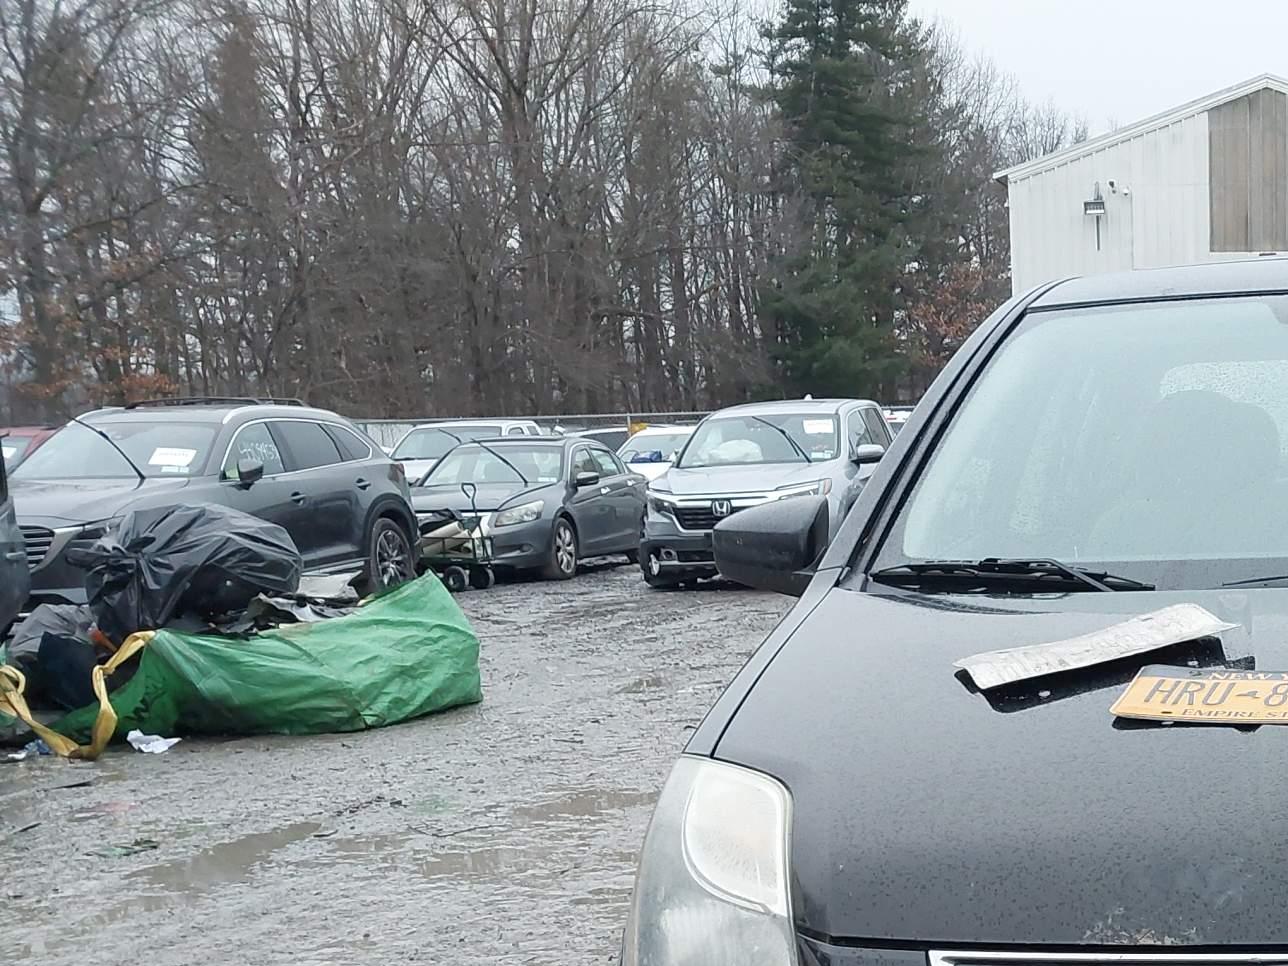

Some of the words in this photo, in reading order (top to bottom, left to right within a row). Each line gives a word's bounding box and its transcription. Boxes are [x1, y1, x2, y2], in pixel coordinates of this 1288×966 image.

[1208, 671, 1274, 681] NEW
[1143, 678, 1237, 707] HRU
[1181, 708, 1257, 718] EMPIRE
